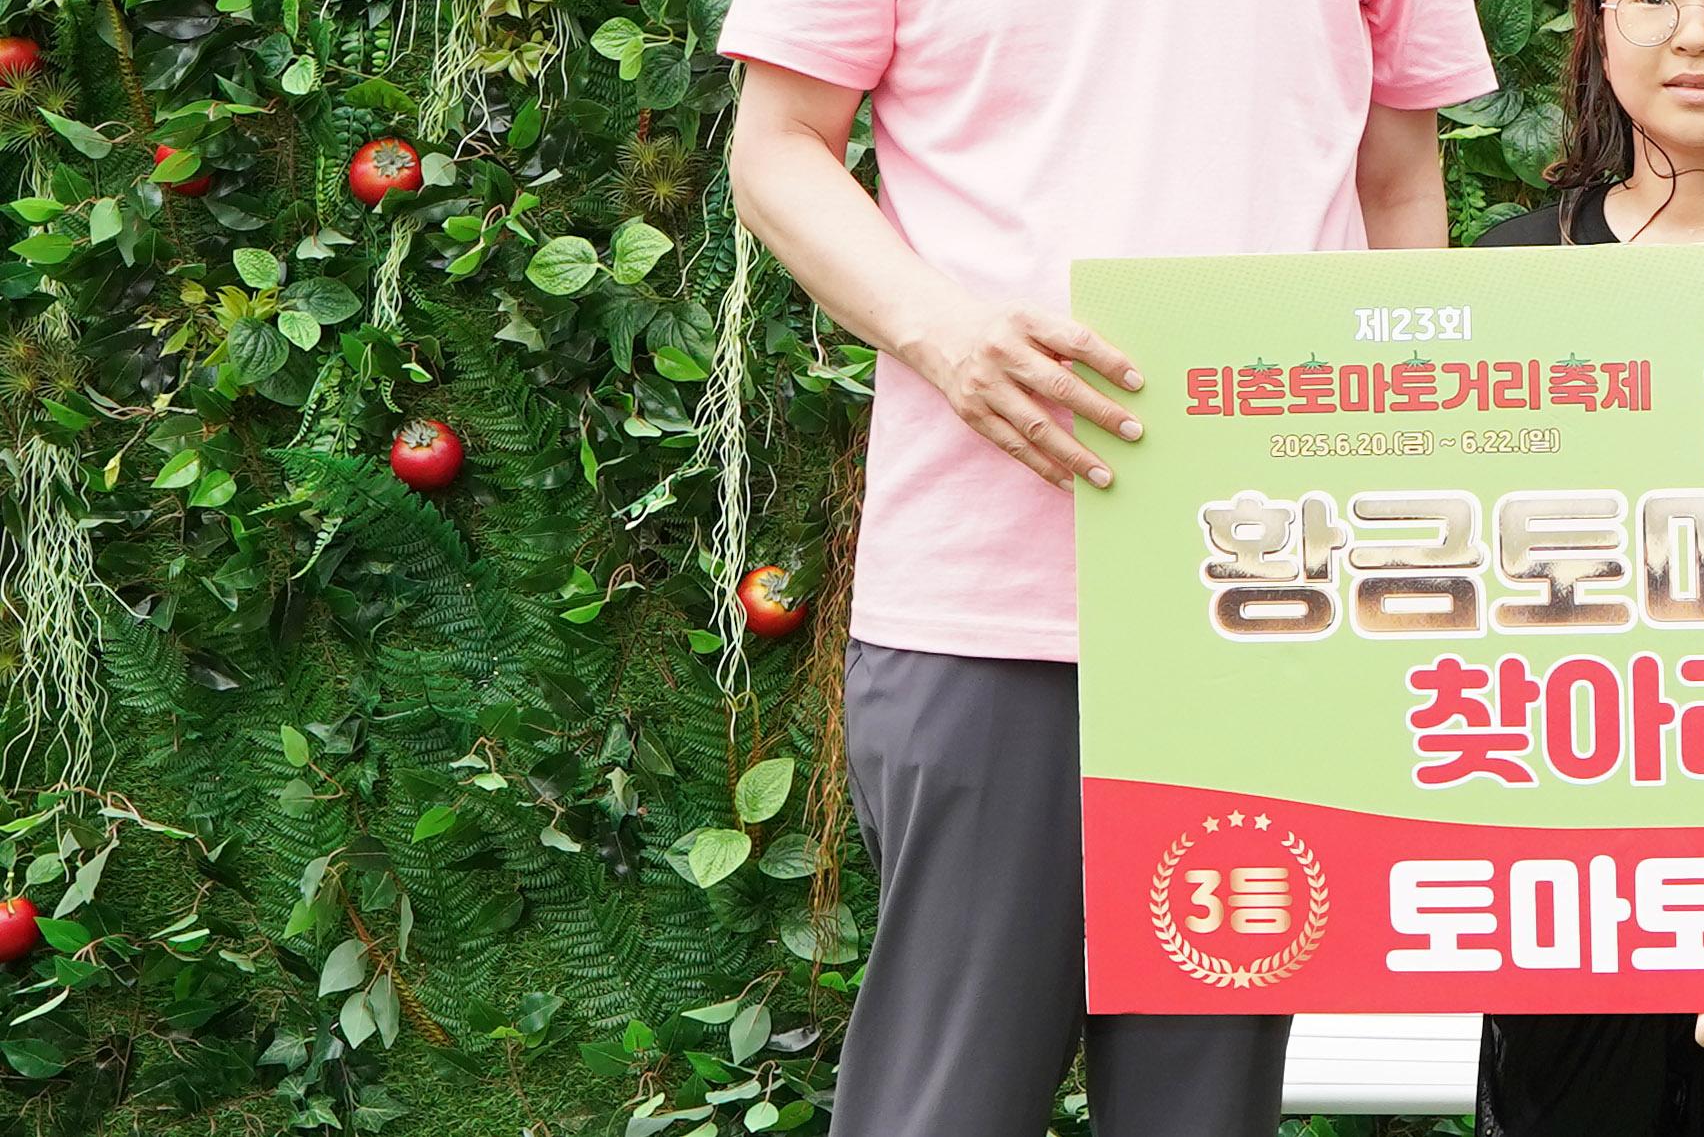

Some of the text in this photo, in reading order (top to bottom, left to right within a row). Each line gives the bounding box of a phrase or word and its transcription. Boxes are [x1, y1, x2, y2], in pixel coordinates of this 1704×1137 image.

[1353, 305, 1473, 343] 제23회
[1270, 430, 1435, 457] 2025.6.20.(금)
[1460, 428, 1562, 454] 6.22.(일)
[1183, 867, 1294, 935] 3등
